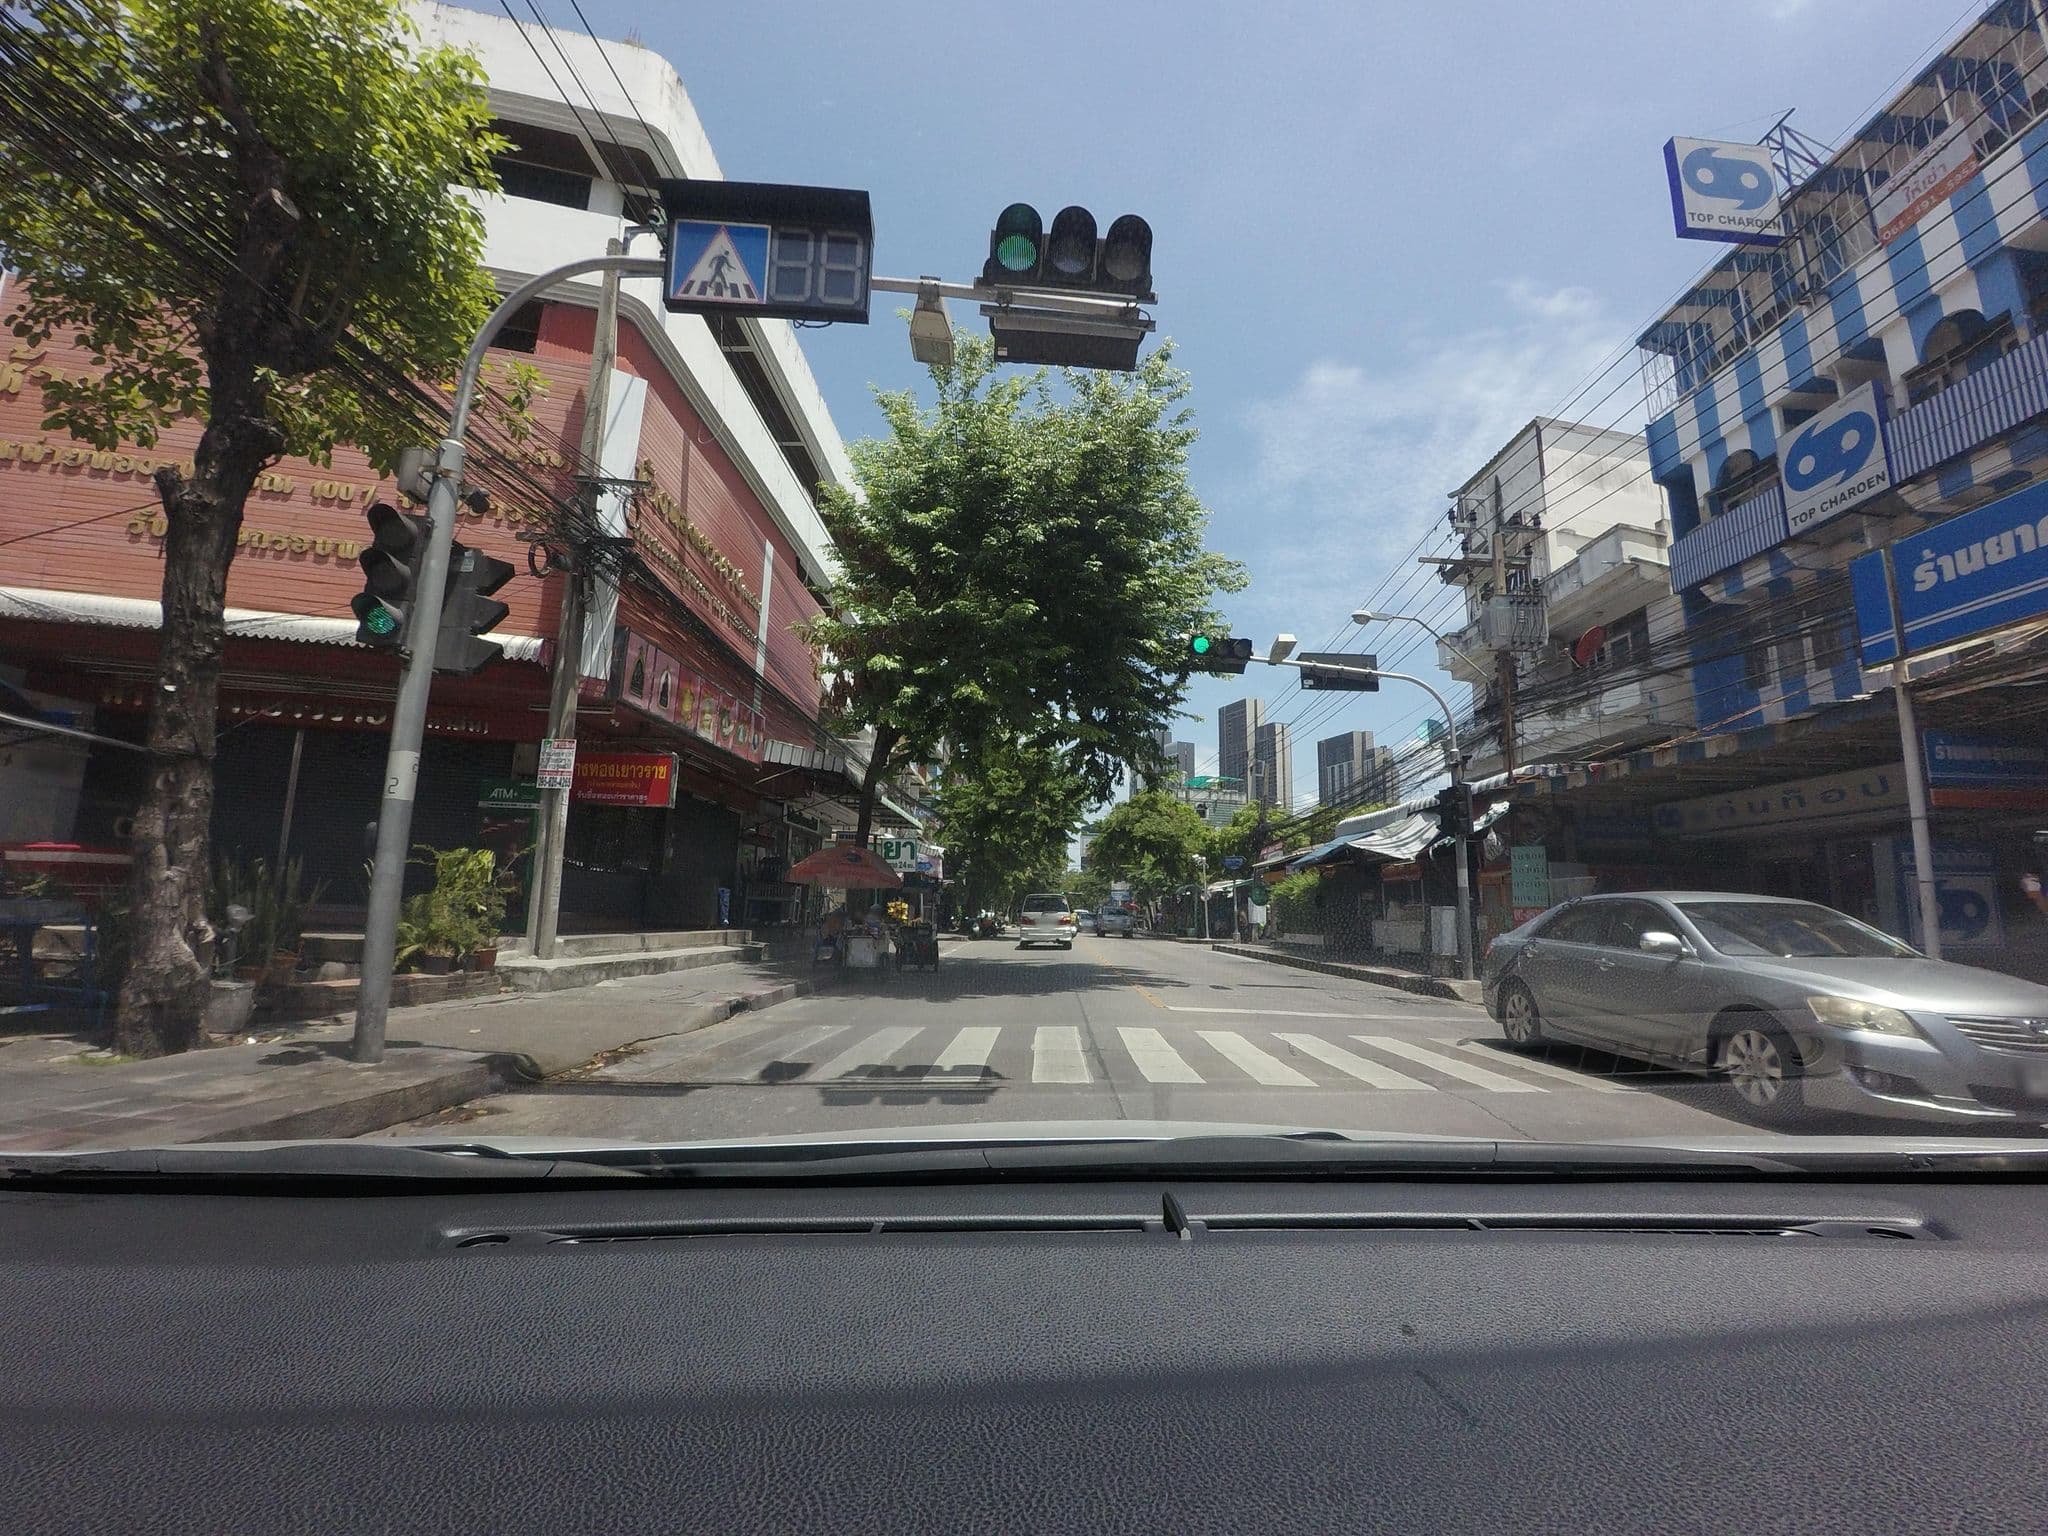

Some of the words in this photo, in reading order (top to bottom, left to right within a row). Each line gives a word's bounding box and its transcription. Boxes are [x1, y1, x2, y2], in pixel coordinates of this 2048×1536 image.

[1688, 212, 1714, 224] TOP
[1718, 215, 1782, 231] CHAROEN
[1791, 507, 1816, 527] TOP
[1820, 471, 1886, 513] CHAROEN
[489, 788, 513, 799] ATM
[884, 841, 915, 860] ยา
